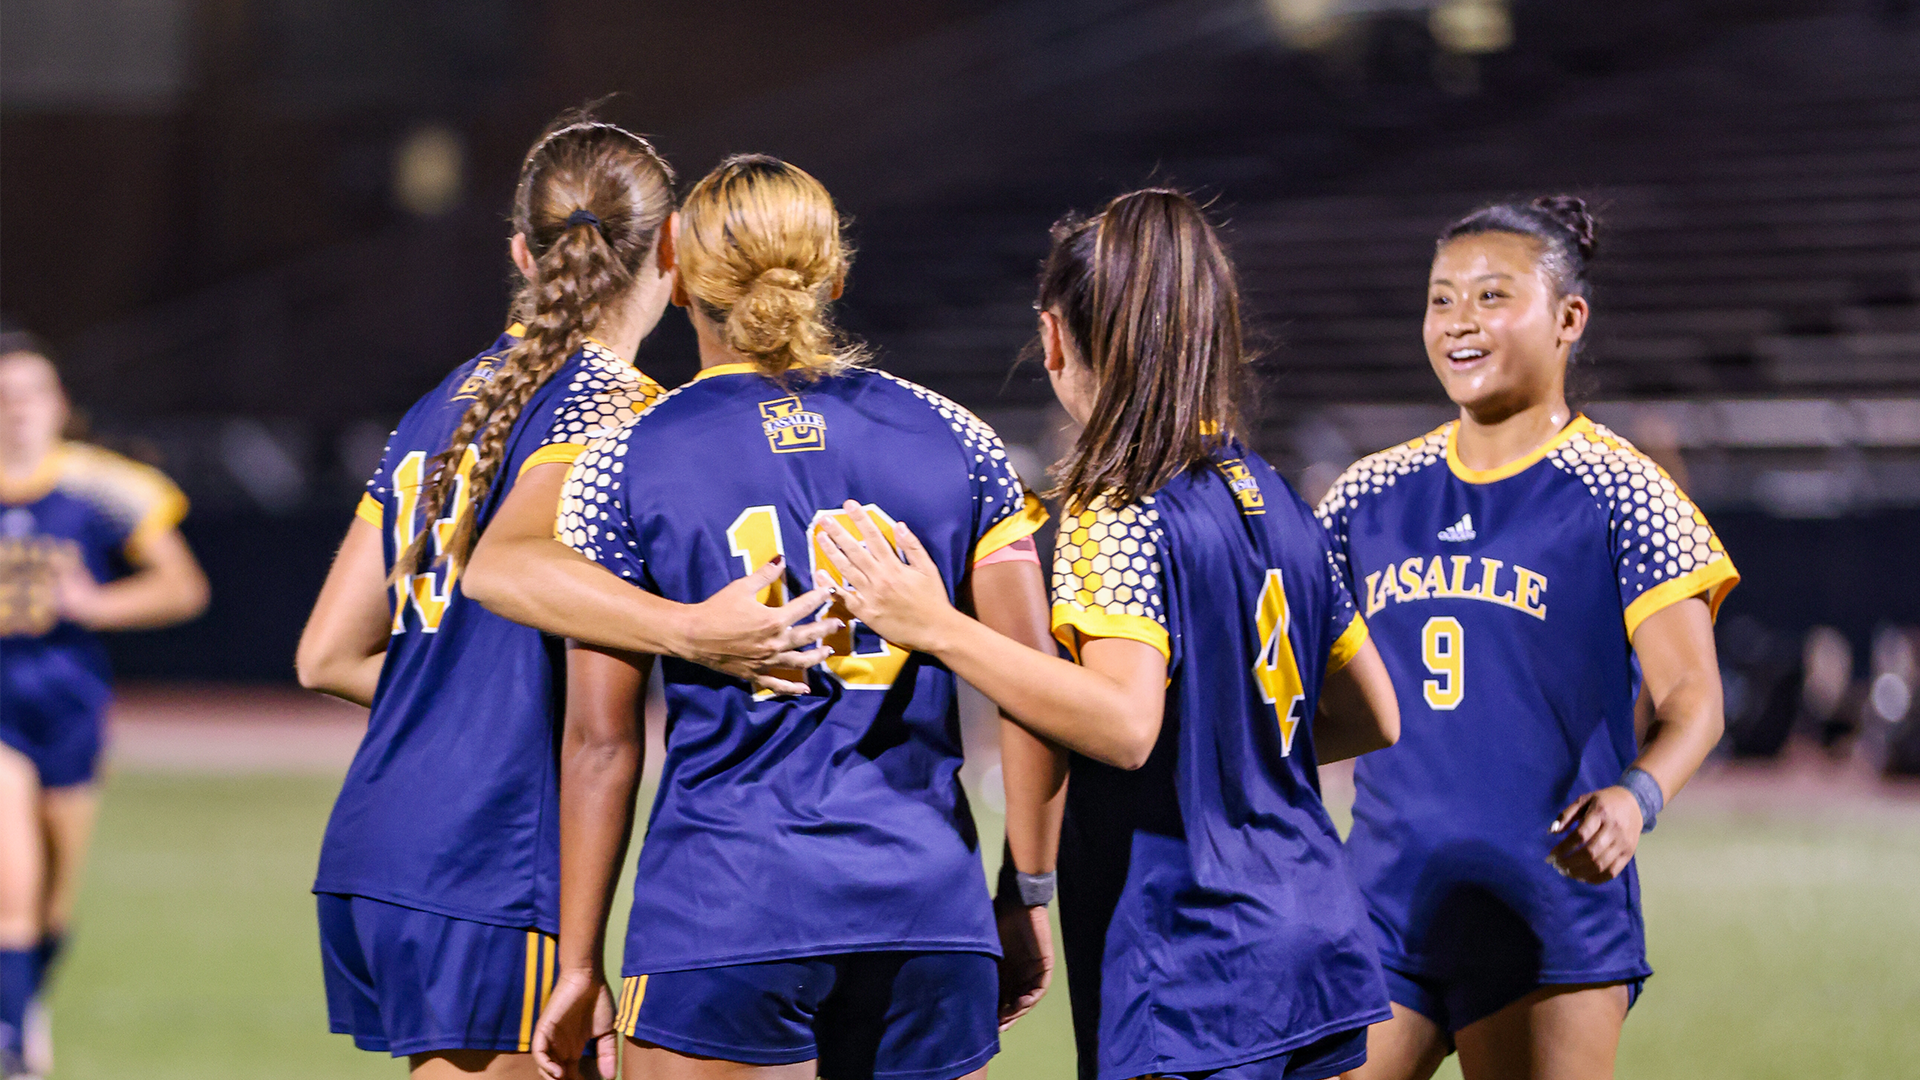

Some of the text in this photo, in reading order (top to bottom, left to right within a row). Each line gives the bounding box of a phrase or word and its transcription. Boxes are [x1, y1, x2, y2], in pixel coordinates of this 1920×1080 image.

[766, 413, 825, 433] LASALLE
[1365, 555, 1547, 621] LASALLE
[1251, 568, 1305, 758] 4
[1421, 616, 1464, 710] 9
